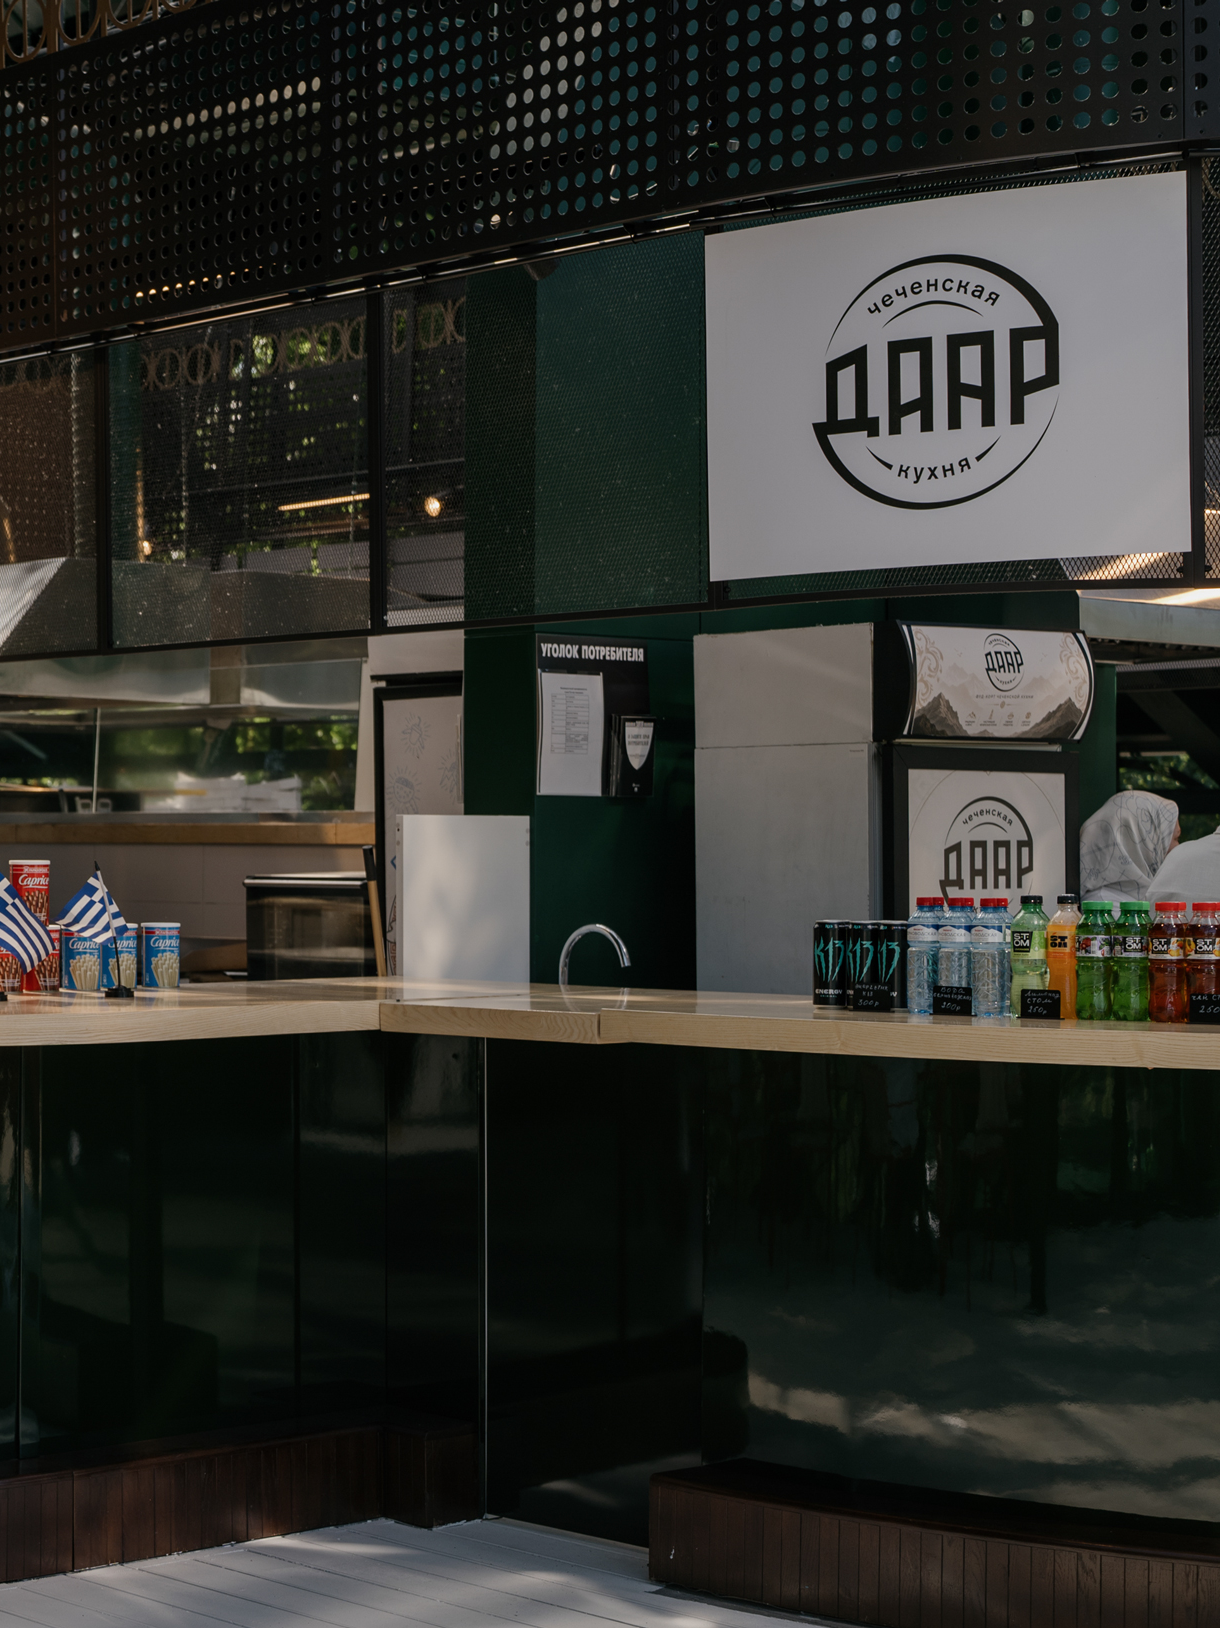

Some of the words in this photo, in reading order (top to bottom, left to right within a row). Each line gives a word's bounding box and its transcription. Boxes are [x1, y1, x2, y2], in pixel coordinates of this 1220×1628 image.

[867, 277, 1001, 317] чеченская
[812, 323, 1060, 438] ДААР
[897, 456, 972, 485] кухня
[540, 643, 579, 659] УГОЛОК
[581, 645, 644, 662] ПОТРЕБИТЕЛЯ
[984, 650, 1024, 674] ДААР
[962, 808, 1014, 827] чеченская
[939, 840, 1034, 890] ДААР
[814, 936, 844, 983] K13
[878, 938, 900, 983] 13
